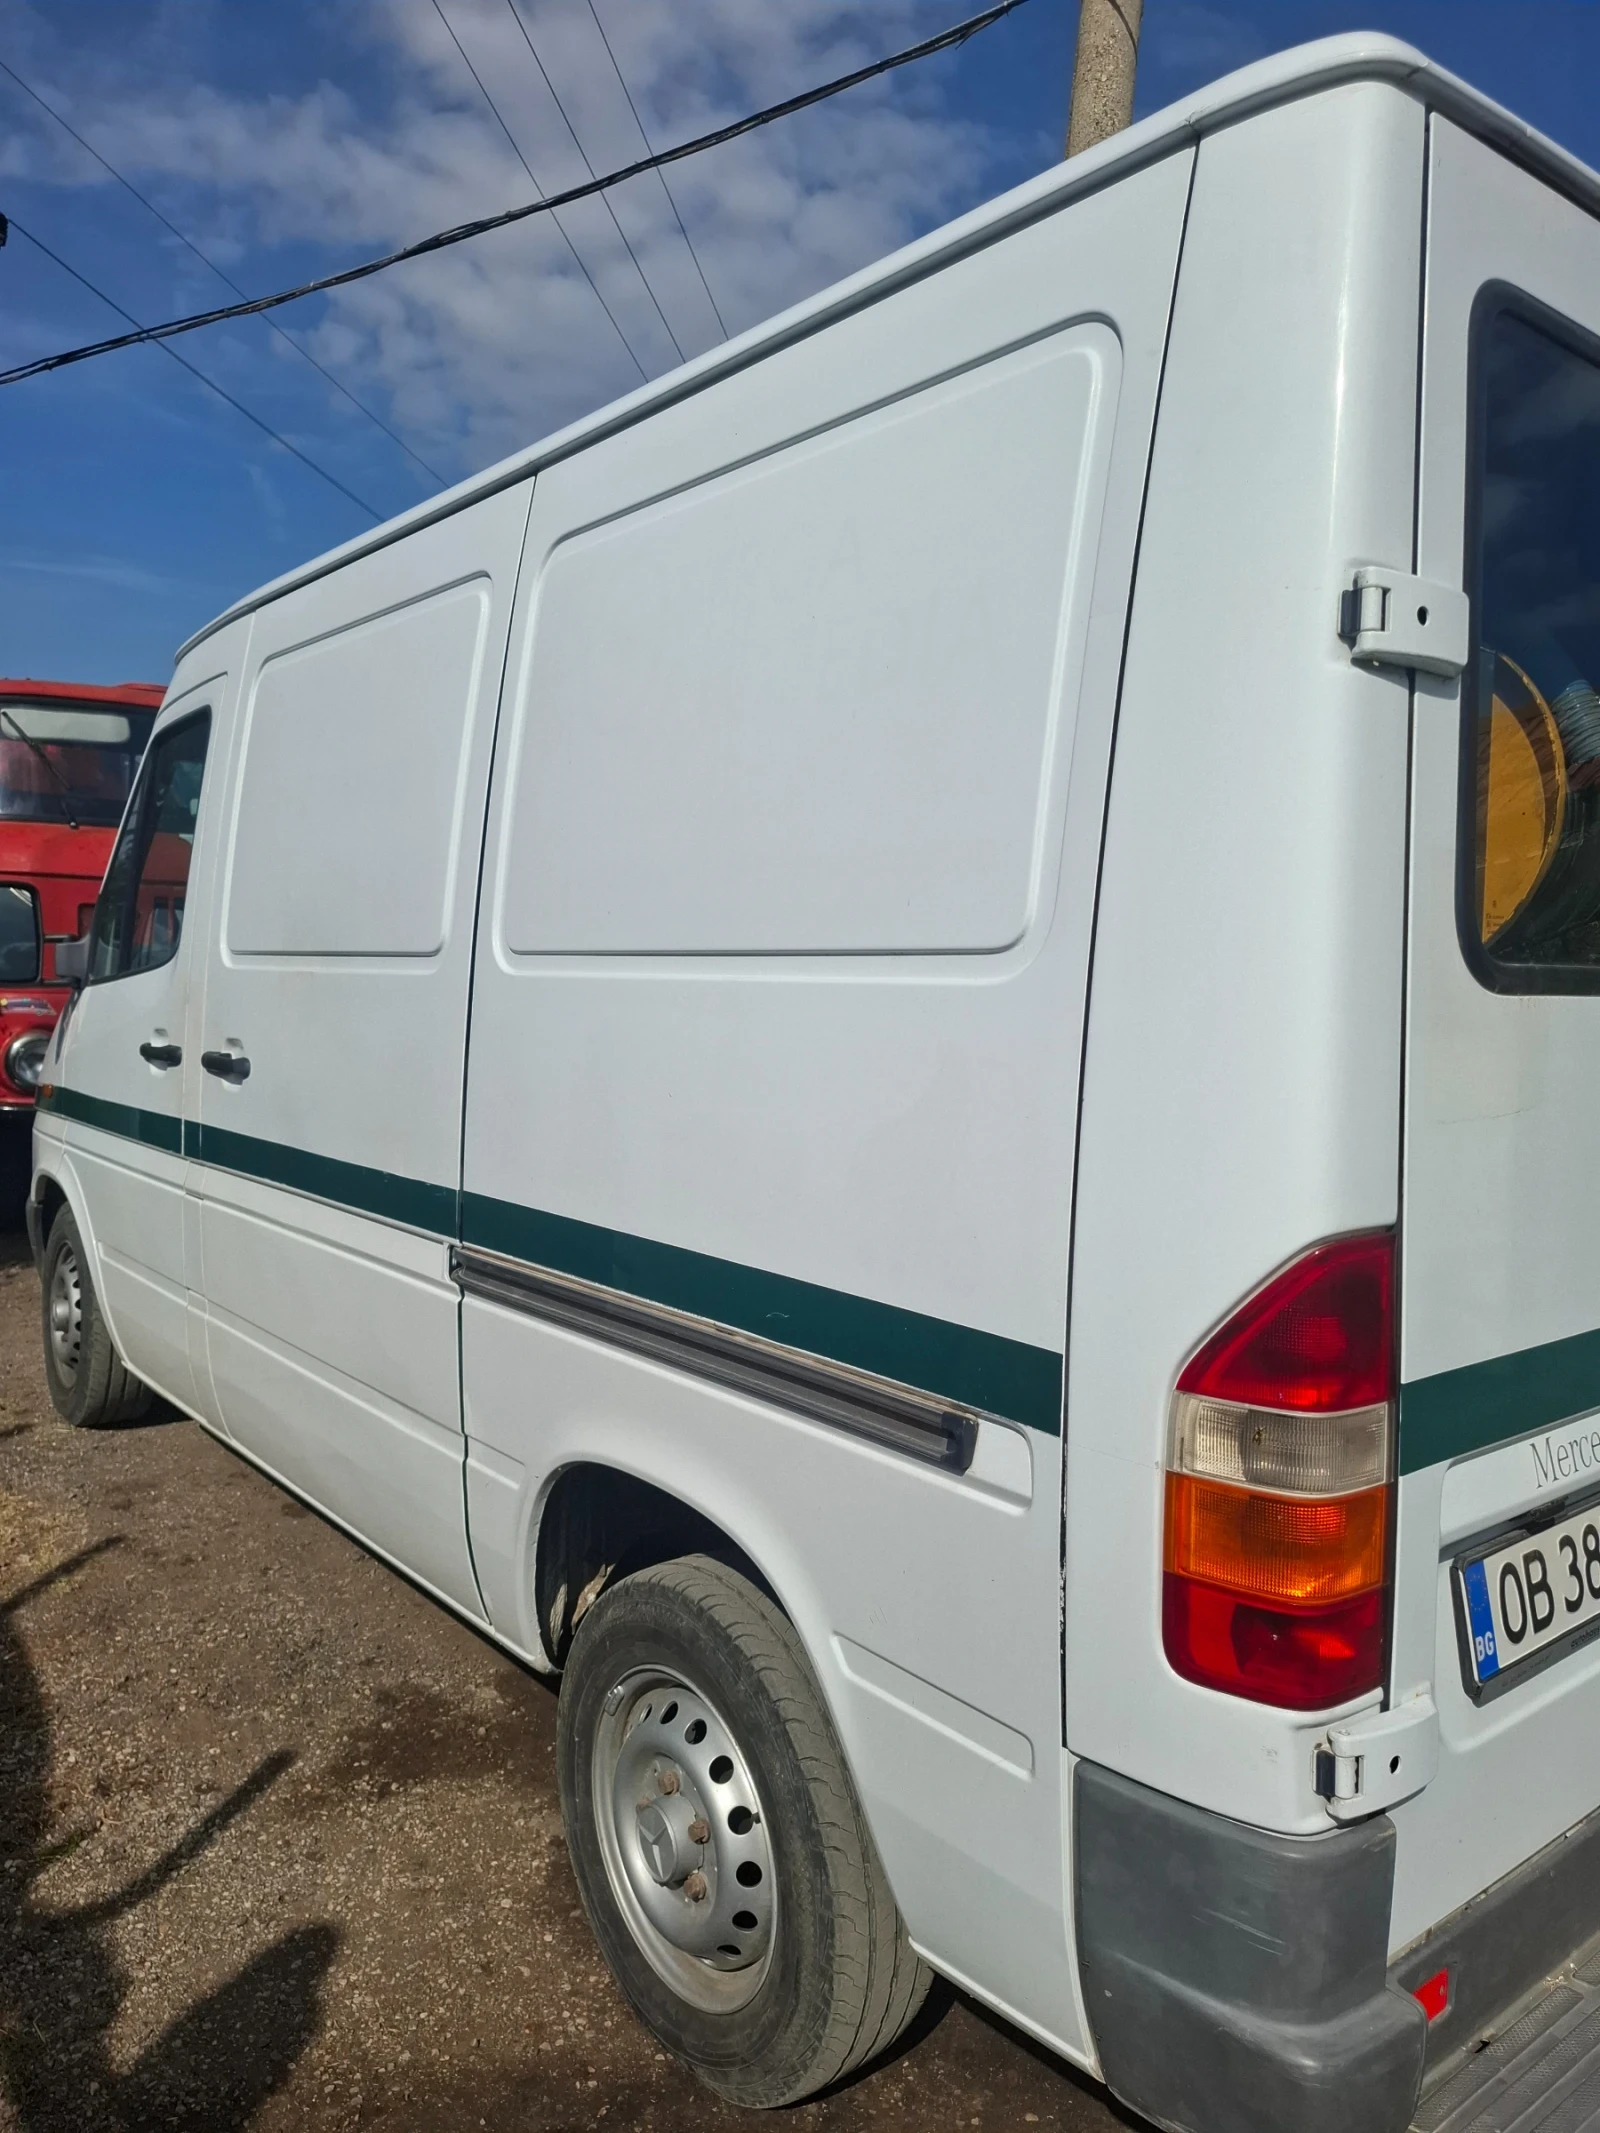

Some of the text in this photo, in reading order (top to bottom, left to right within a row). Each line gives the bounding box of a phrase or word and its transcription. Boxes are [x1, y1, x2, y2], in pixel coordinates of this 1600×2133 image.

[1529, 1431, 1600, 1489] Merce
[1500, 1523, 1600, 1645] OB 38
[1475, 1632, 1495, 1662] BG
